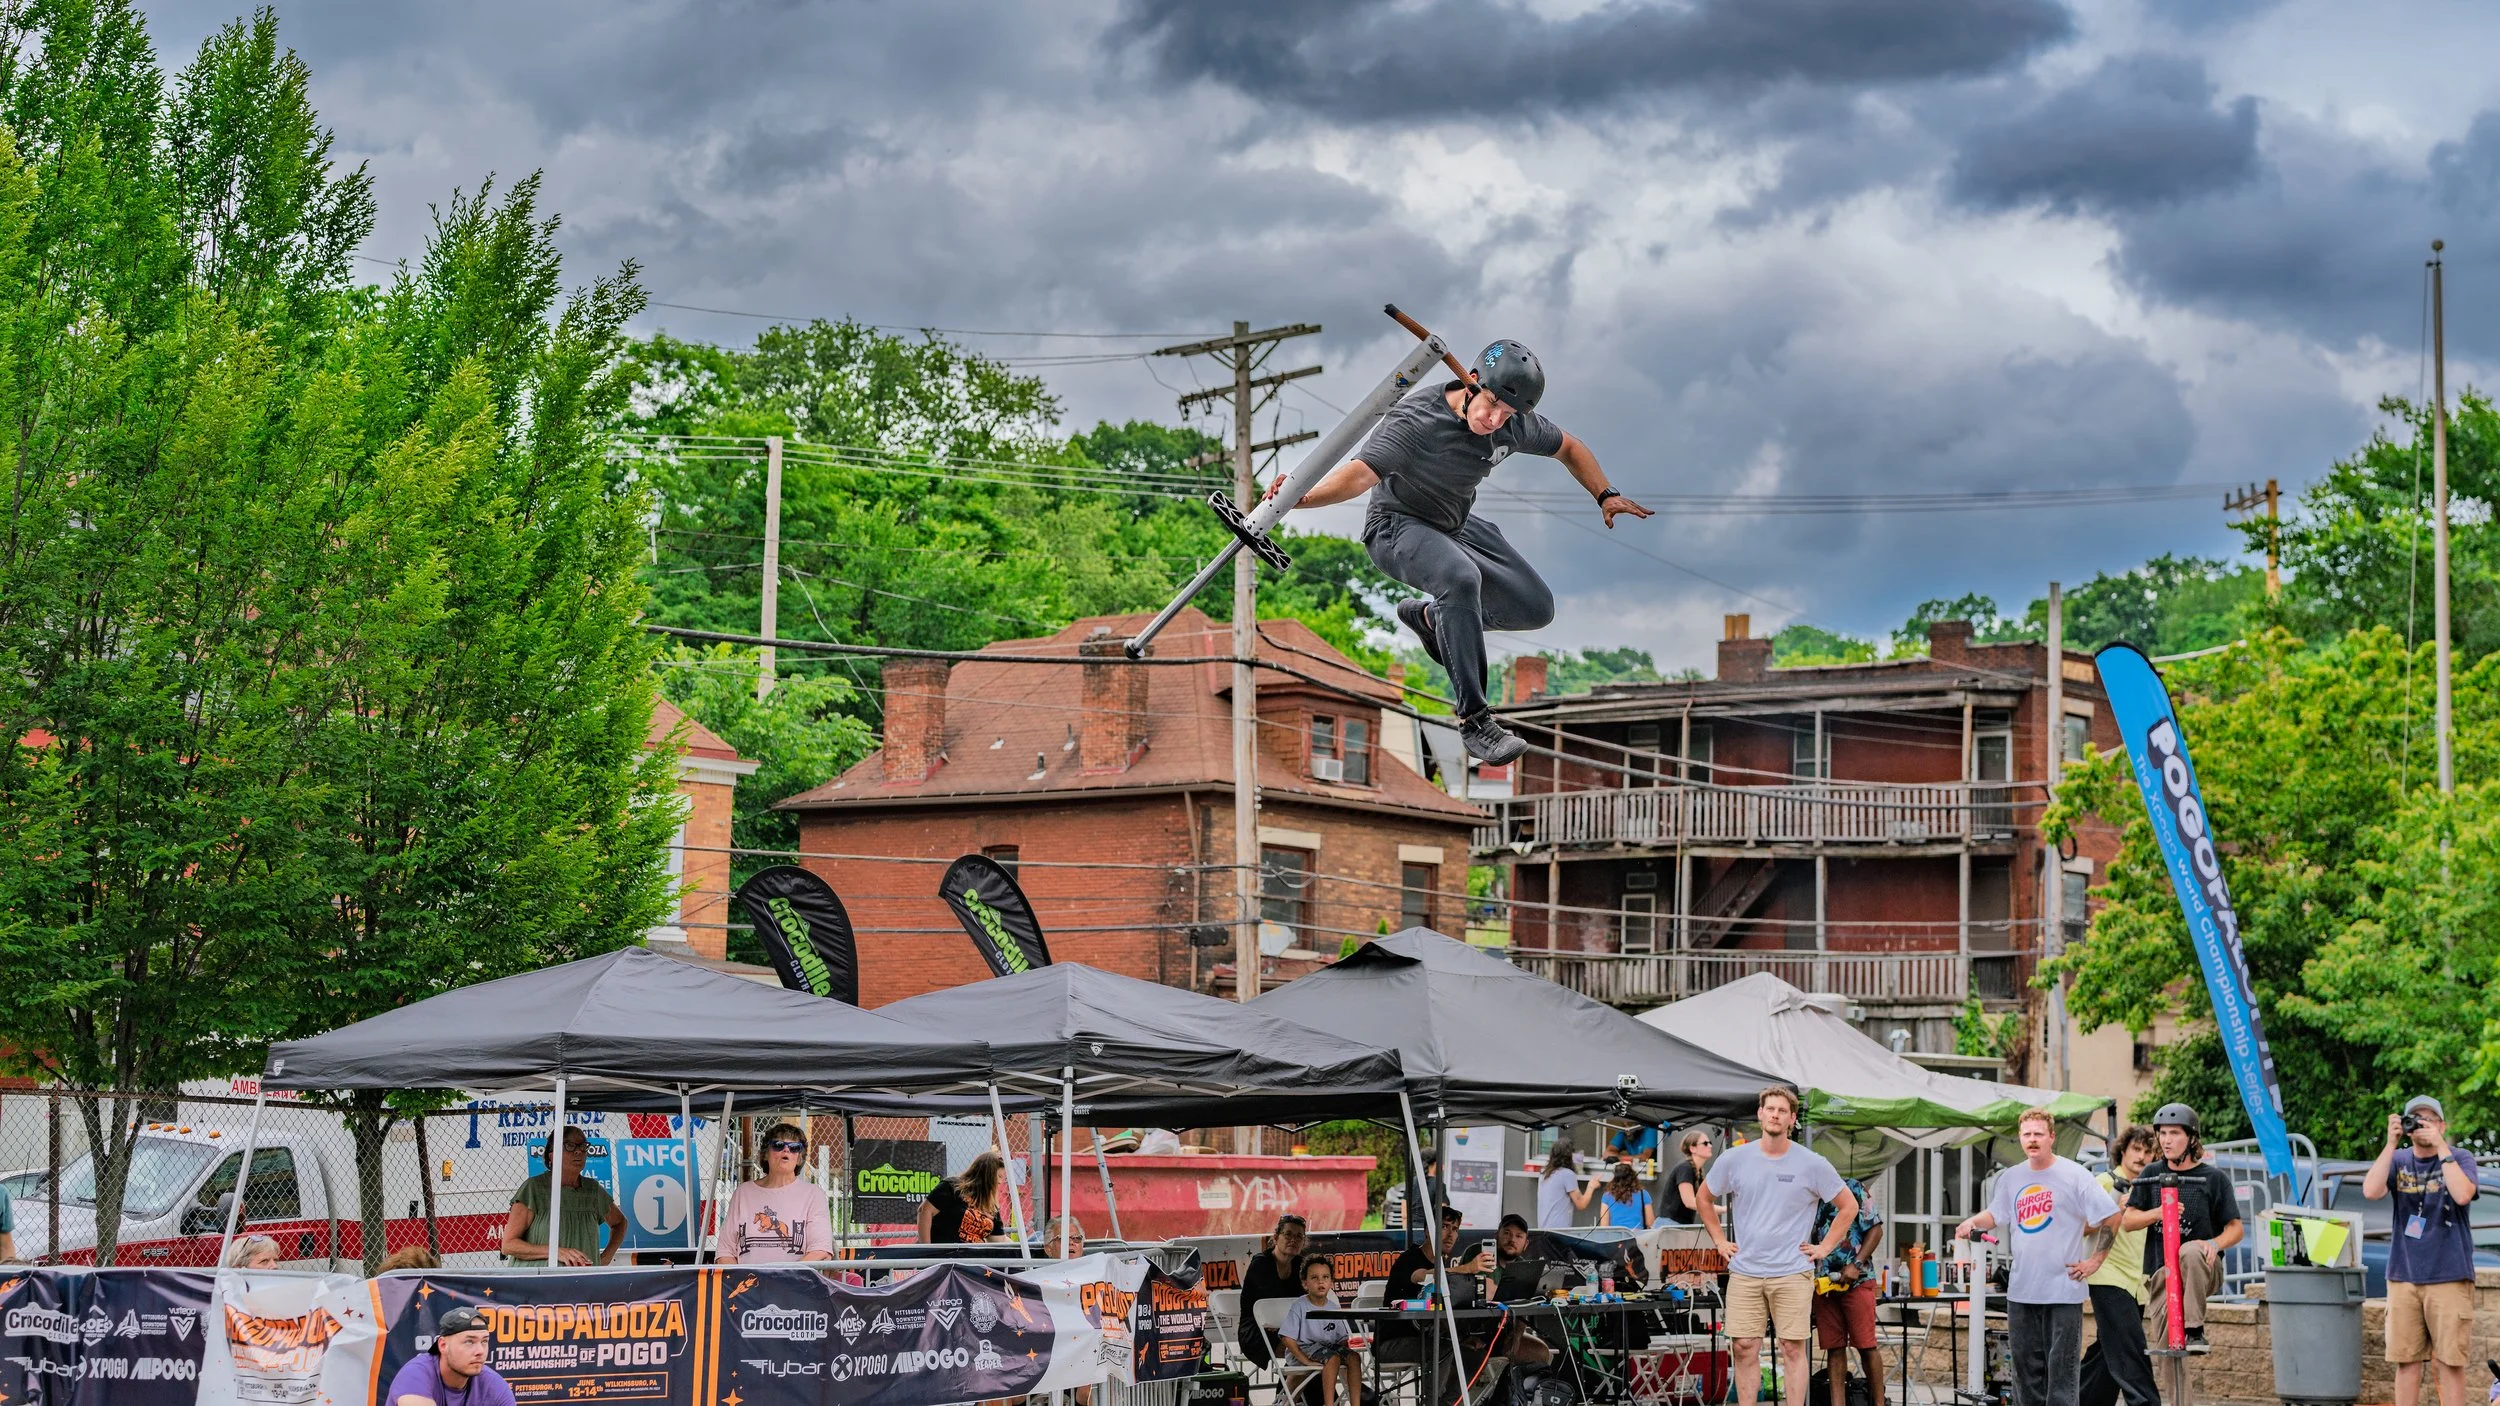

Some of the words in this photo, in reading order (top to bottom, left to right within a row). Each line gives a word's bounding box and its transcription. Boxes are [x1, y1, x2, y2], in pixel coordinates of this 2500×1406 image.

[963, 888, 1029, 974] Crocodil
[2136, 753, 2151, 788] The
[2178, 858, 2204, 914] World
[2200, 917, 2250, 1058] Championship
[2243, 1060, 2264, 1117] Series
[769, 897, 831, 997] Crocodile
[995, 950, 1012, 974] CLOT
[857, 1168, 939, 1194] Crocodile
[906, 1193, 927, 1203] CLOT
[2016, 1191, 2053, 1209] BURGER
[2018, 1200, 2053, 1223] KING
[8, 1312, 79, 1335] Crocodile
[478, 1301, 684, 1343] POGOPALOOZA
[744, 1312, 826, 1331] Crocodile
[896, 1322, 926, 1330] PARTNERSHIP
[1160, 1315, 1170, 1325] THE
[1171, 1313, 1193, 1324] WORLD
[790, 1331, 816, 1339] CLOTH
[496, 1346, 524, 1360] THE
[527, 1345, 578, 1359] WORLD
[580, 1349, 596, 1361] OF
[597, 1341, 668, 1367] POGO
[88, 1357, 128, 1379] XPOGO
[495, 1358, 578, 1371] CHAMPIONSHIPS
[854, 1354, 888, 1377] XPOGO
[975, 1359, 1004, 1372] REAPER
[576, 1379, 596, 1387] JUNE
